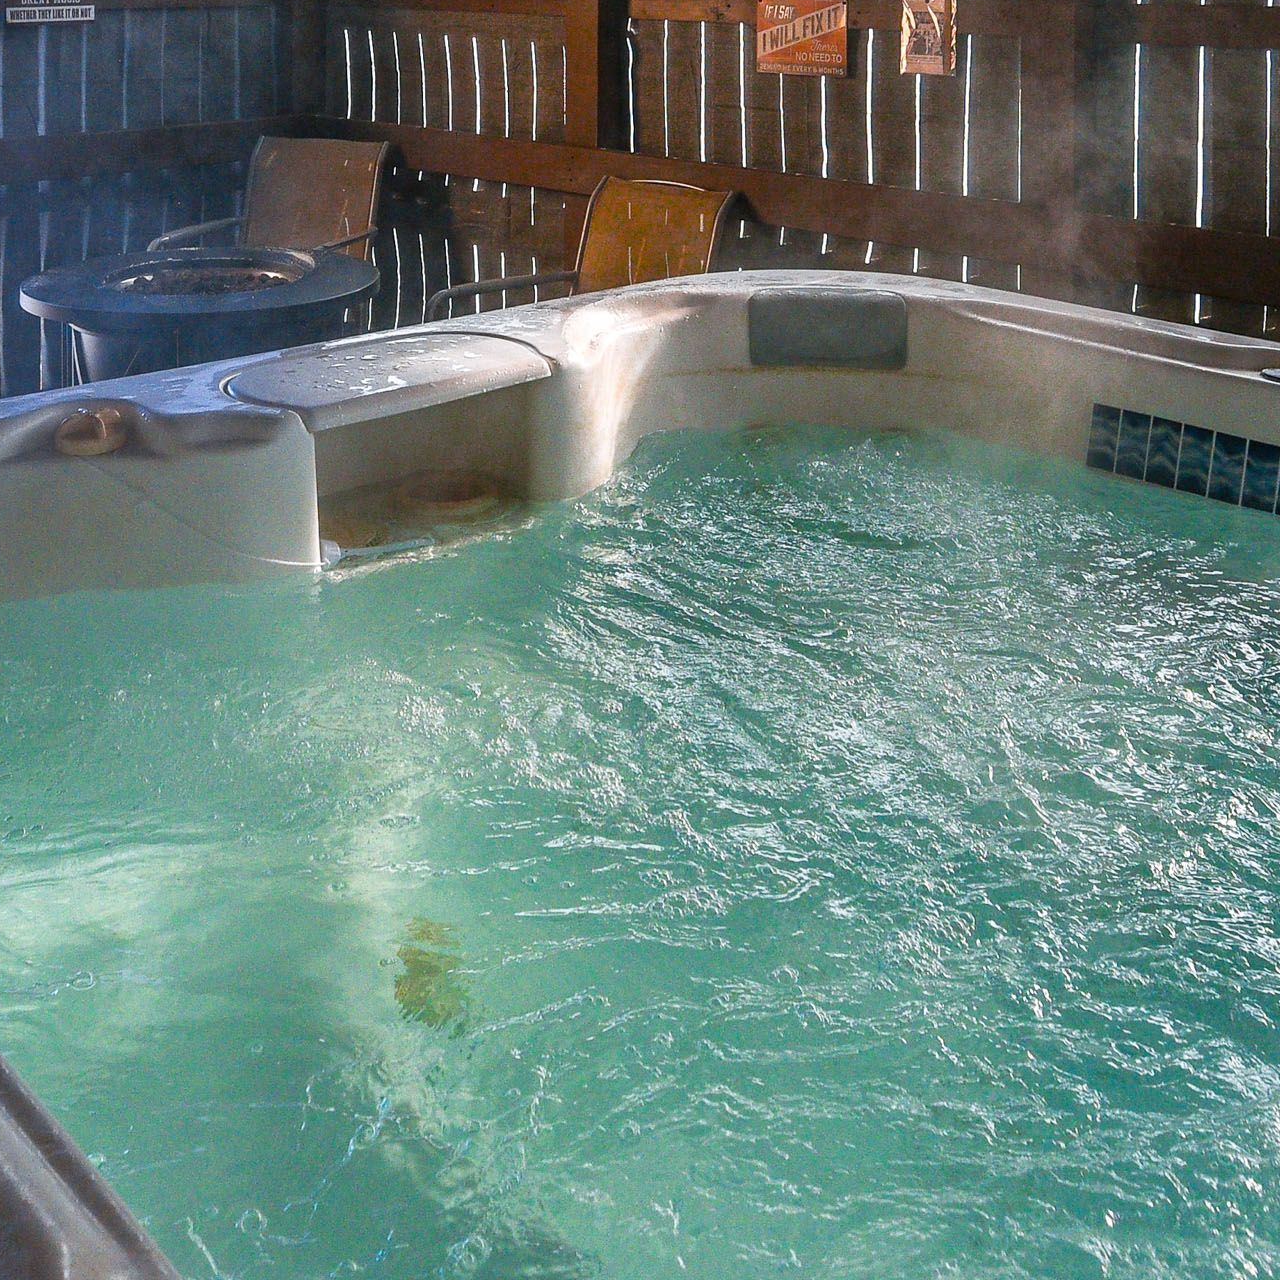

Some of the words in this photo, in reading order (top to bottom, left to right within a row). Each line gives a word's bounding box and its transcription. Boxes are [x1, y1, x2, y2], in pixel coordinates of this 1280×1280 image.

[38, 9, 52, 20] THEY
[53, 8, 65, 19] LIKE
[764, 4, 774, 19] IF
[778, 4, 795, 20] SAY
[762, 32, 767, 52] I
[769, 22, 800, 50] WILL
[802, 11, 824, 39] FIX
[826, 5, 840, 31] IT
[795, 51, 808, 61] NO
[809, 52, 831, 62] NEED
[831, 53, 843, 64] TO
